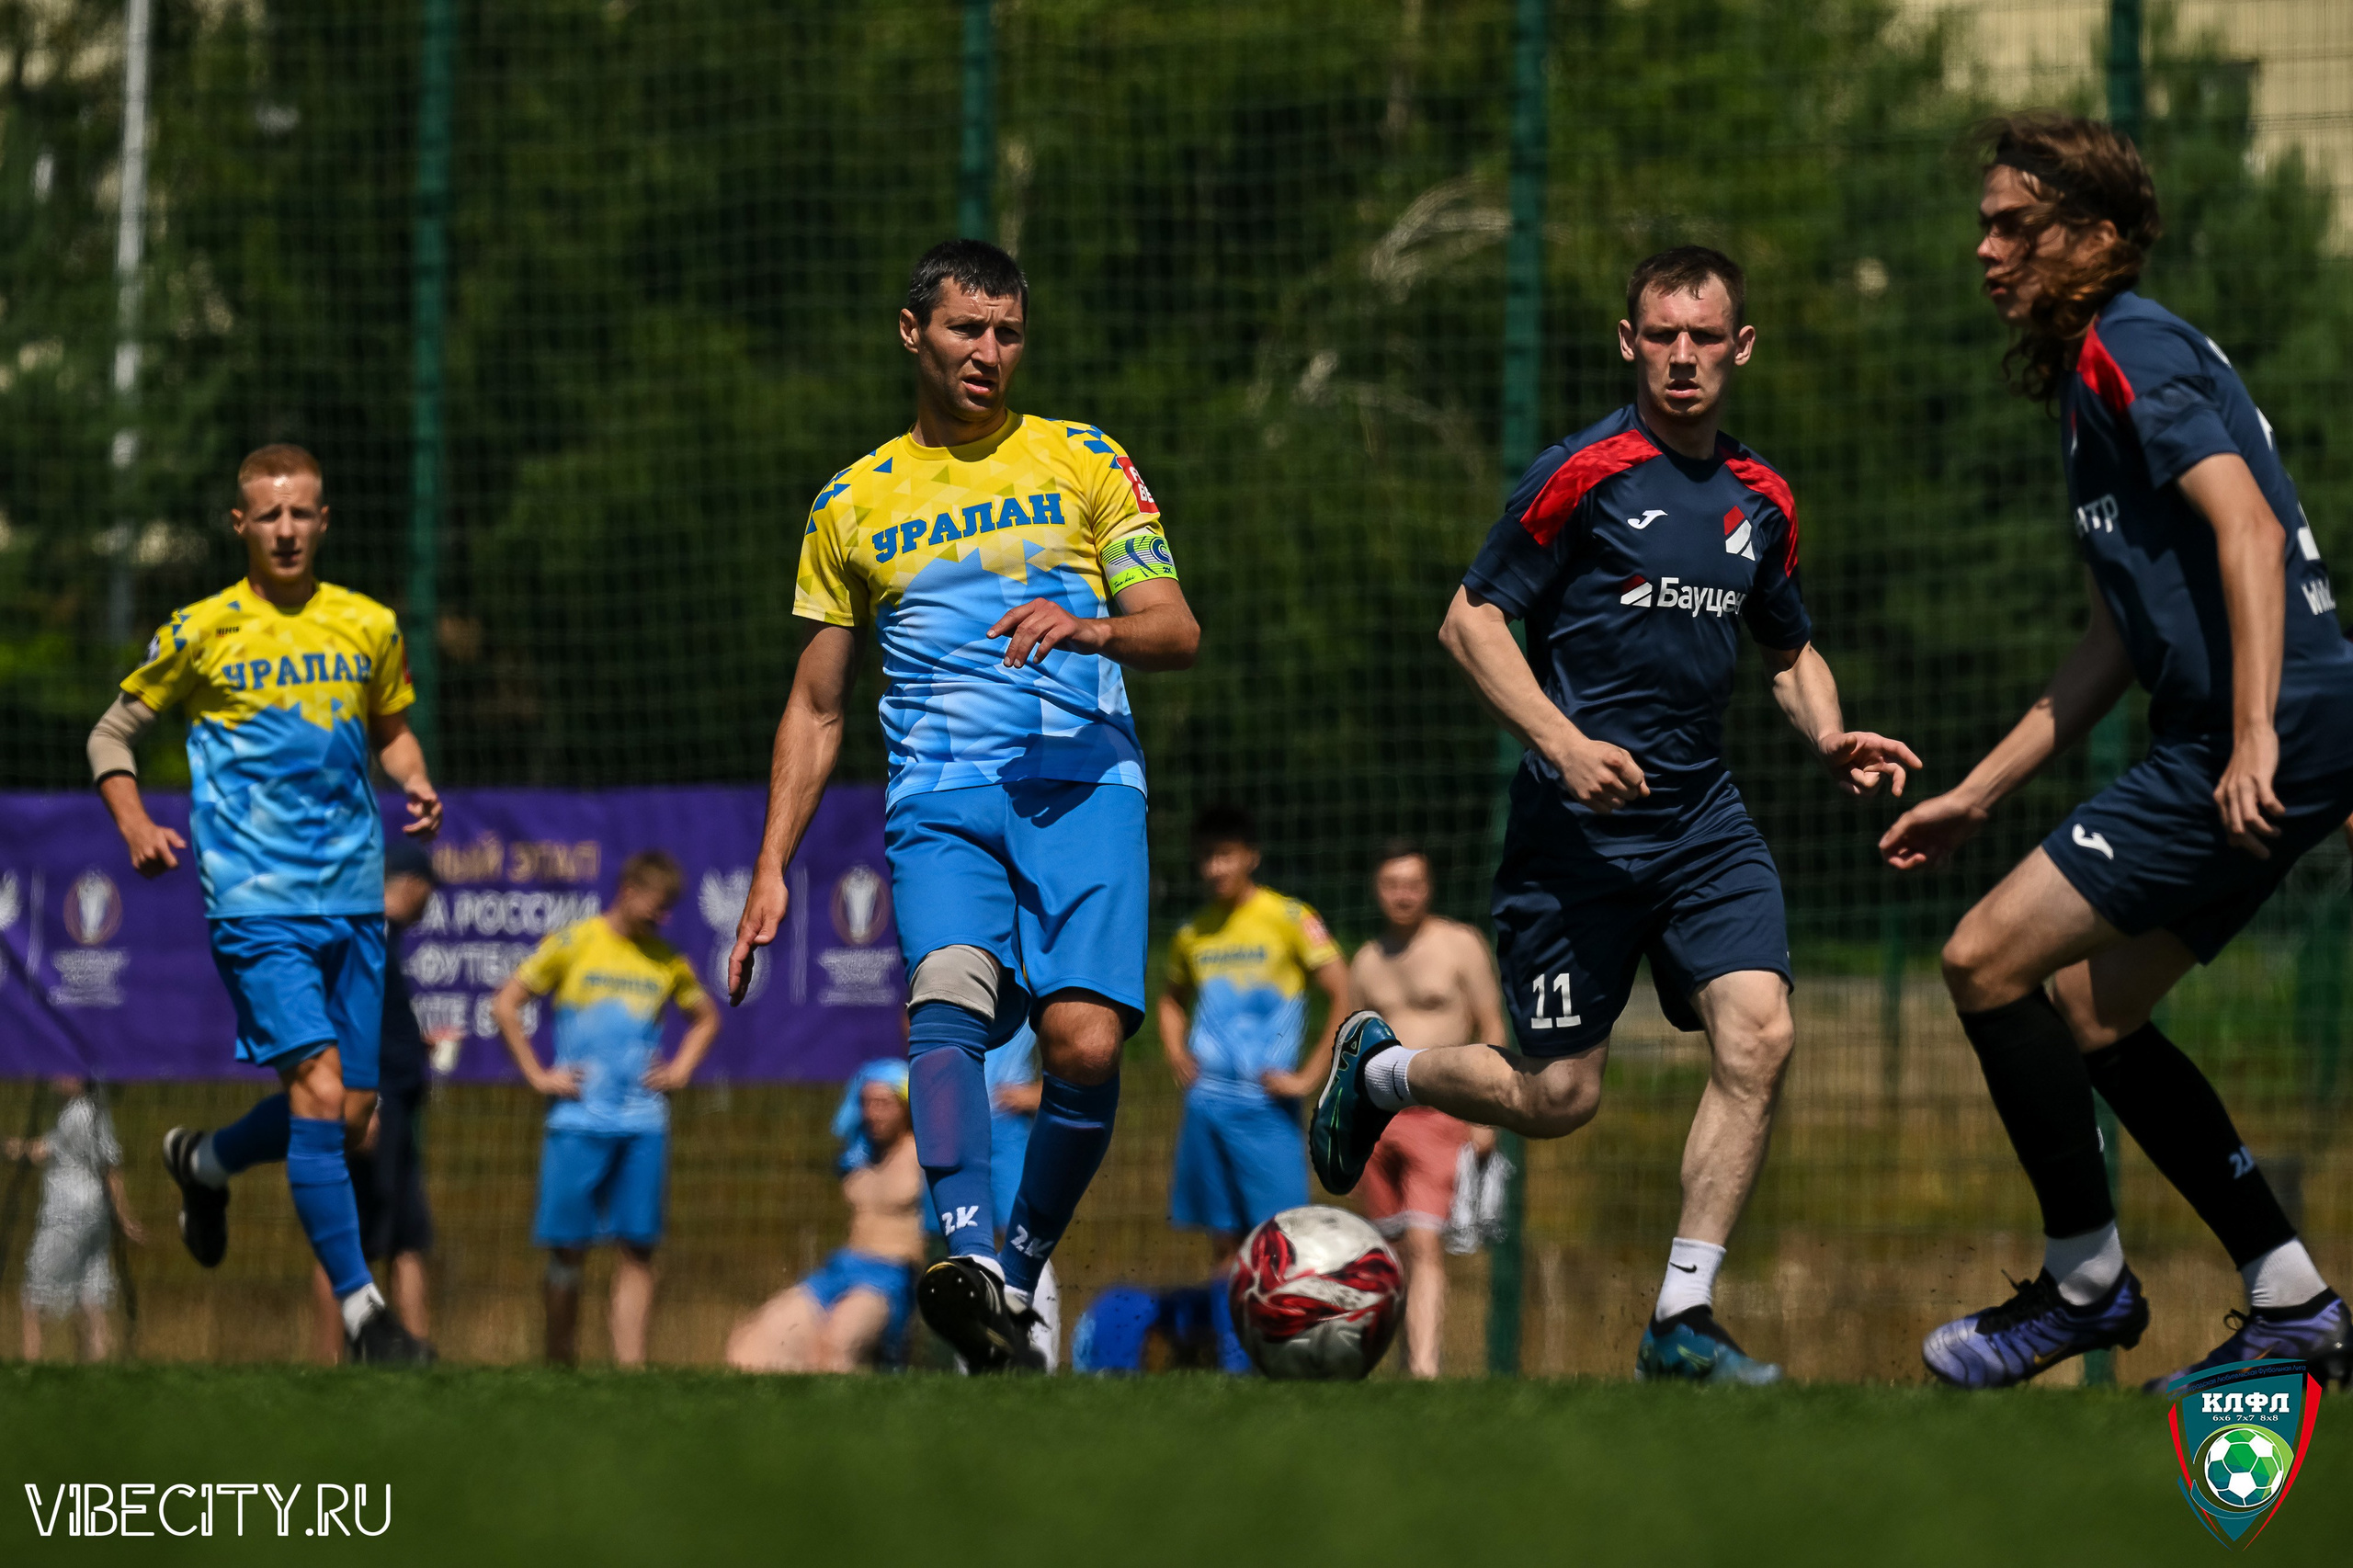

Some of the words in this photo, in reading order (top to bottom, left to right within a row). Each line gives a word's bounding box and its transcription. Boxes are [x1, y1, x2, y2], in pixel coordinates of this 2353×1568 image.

[872, 493, 1065, 563] УРАЛАН
[222, 653, 371, 692] УРАЛАН
[1531, 973, 1581, 1028] 11
[942, 1206, 979, 1236] 2K
